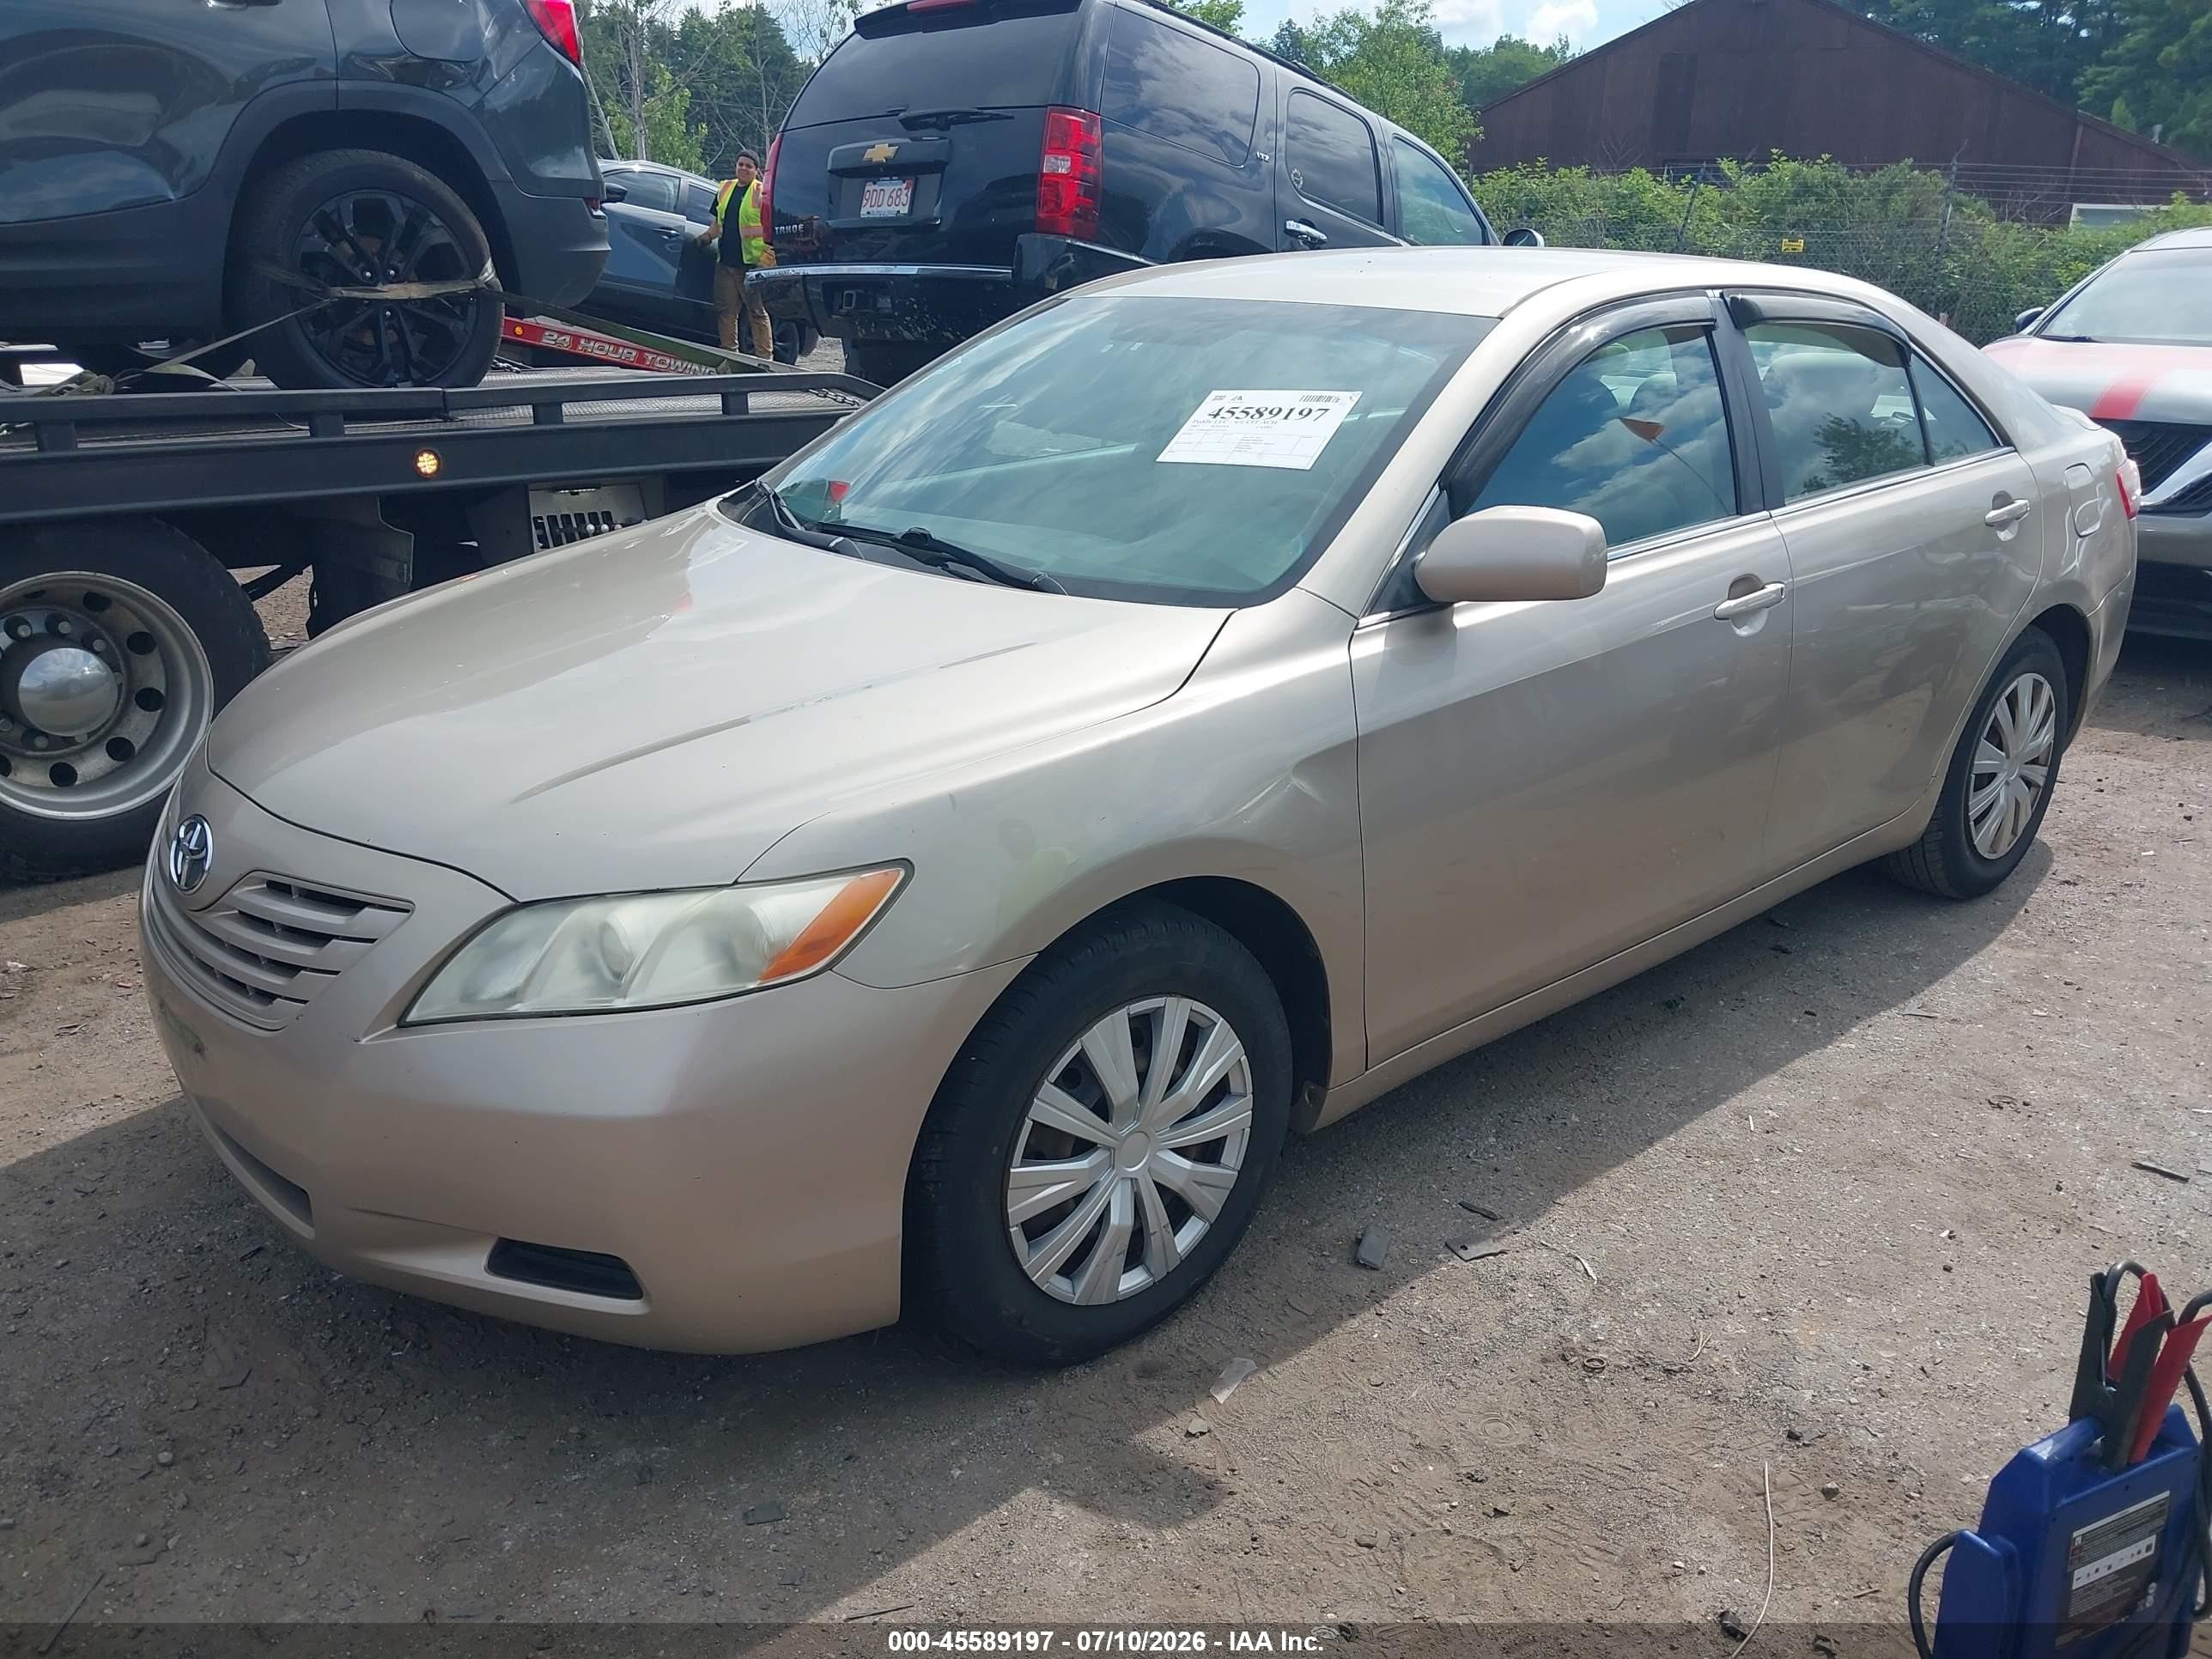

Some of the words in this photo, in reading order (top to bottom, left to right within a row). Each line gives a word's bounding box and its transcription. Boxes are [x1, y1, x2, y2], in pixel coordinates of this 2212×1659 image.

[887, 188, 908, 207] 683
[775, 223, 805, 235] TAHOE
[542, 331, 571, 348] 24
[578, 337, 636, 361] HOUR
[644, 352, 718, 375] TOWING
[1208, 406, 1330, 422] 45589197
